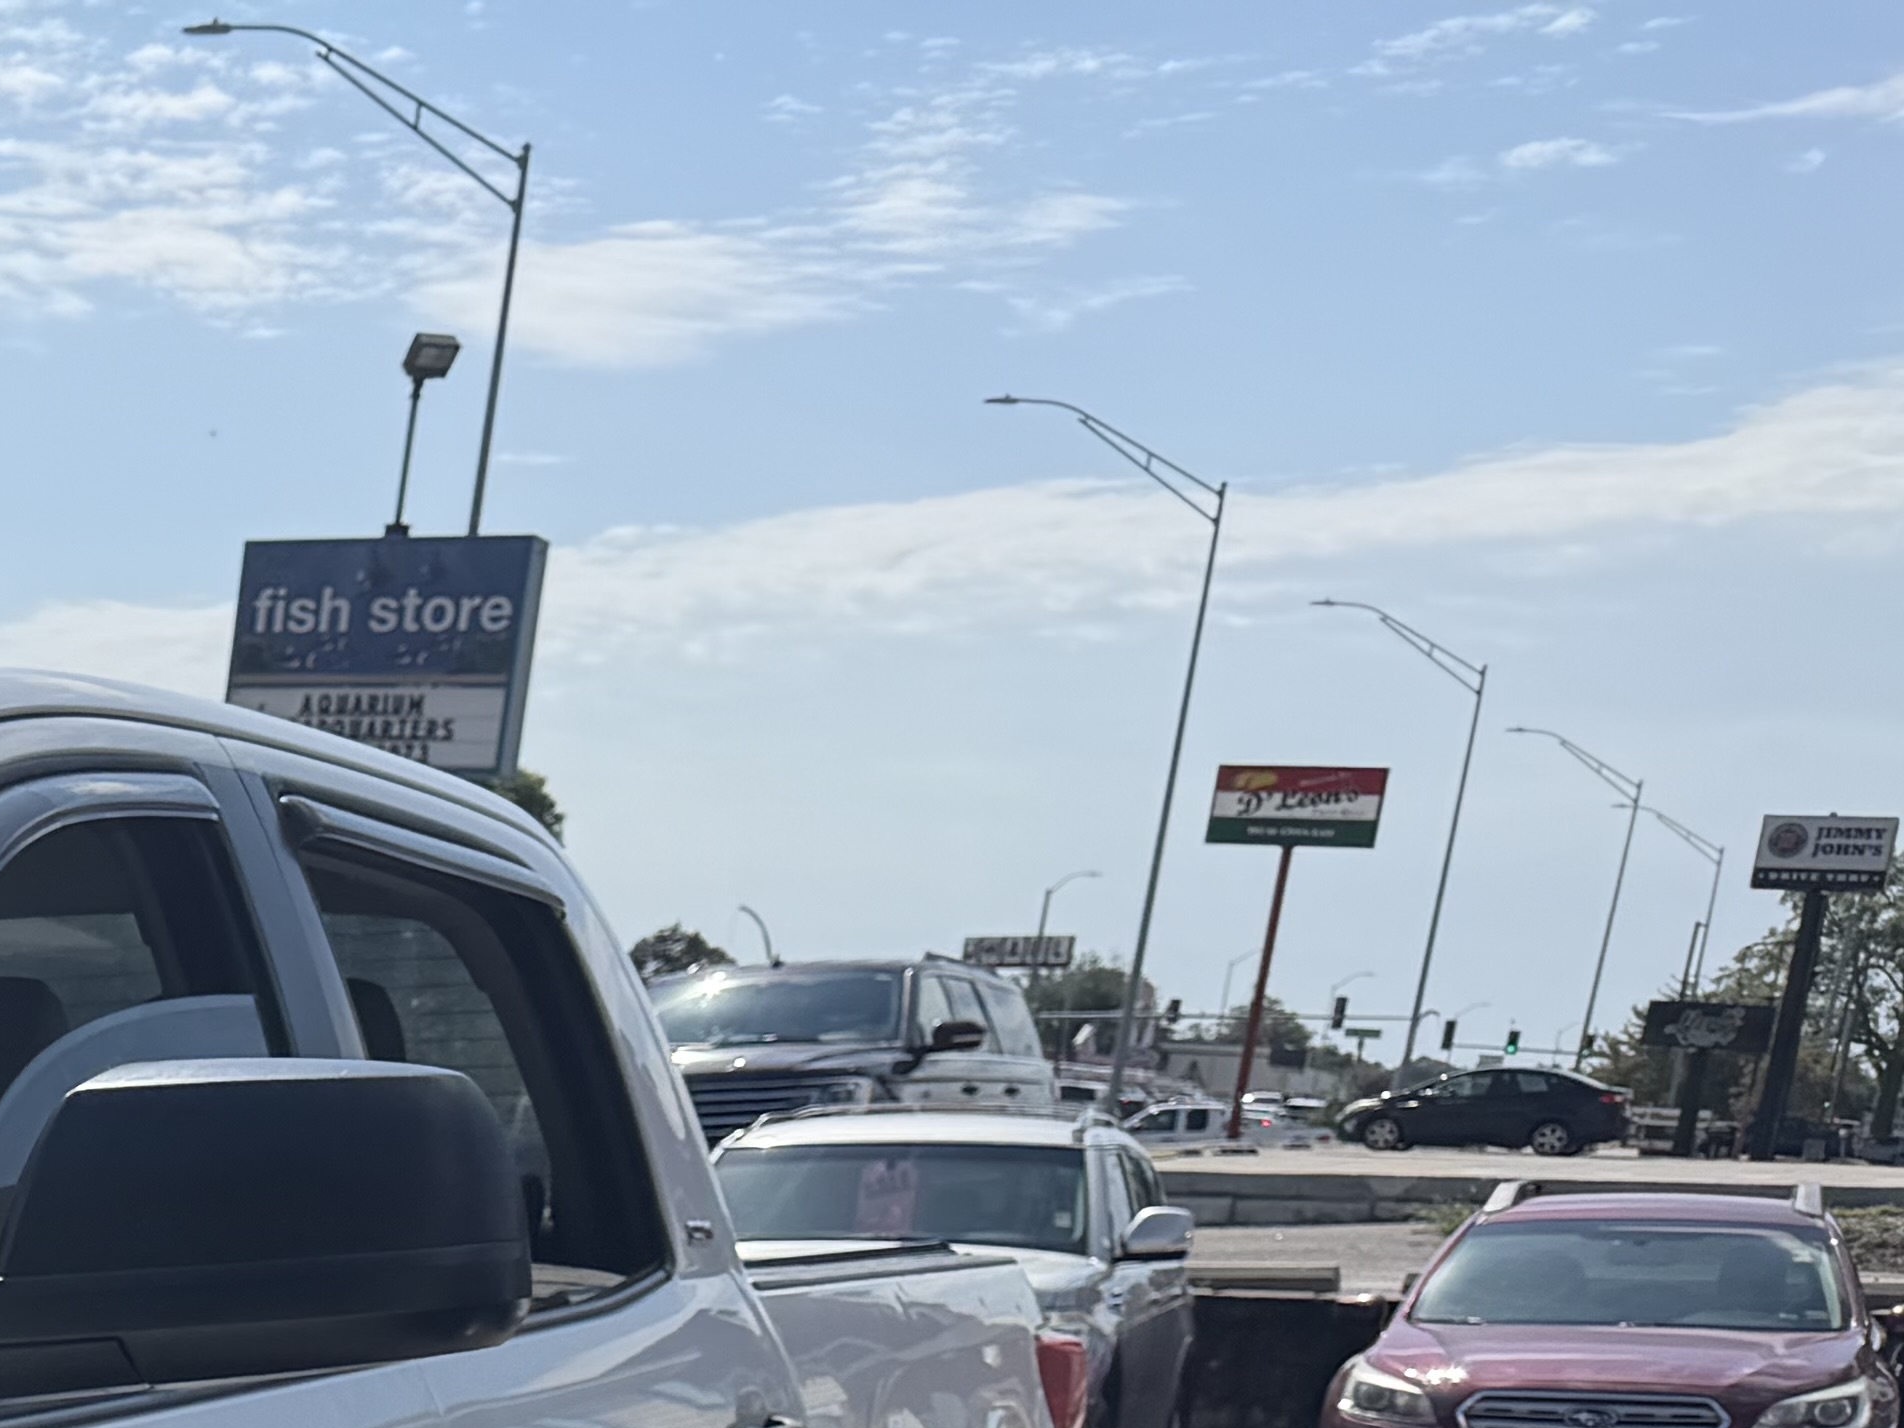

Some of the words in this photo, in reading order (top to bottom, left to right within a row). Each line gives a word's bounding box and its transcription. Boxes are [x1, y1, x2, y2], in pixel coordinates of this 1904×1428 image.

[253, 586, 351, 634] fish
[368, 588, 513, 634] store
[299, 693, 426, 717] AQUARIUM
[1816, 826, 1887, 841] JIMMY
[1811, 843, 1883, 858] JOHN'S
